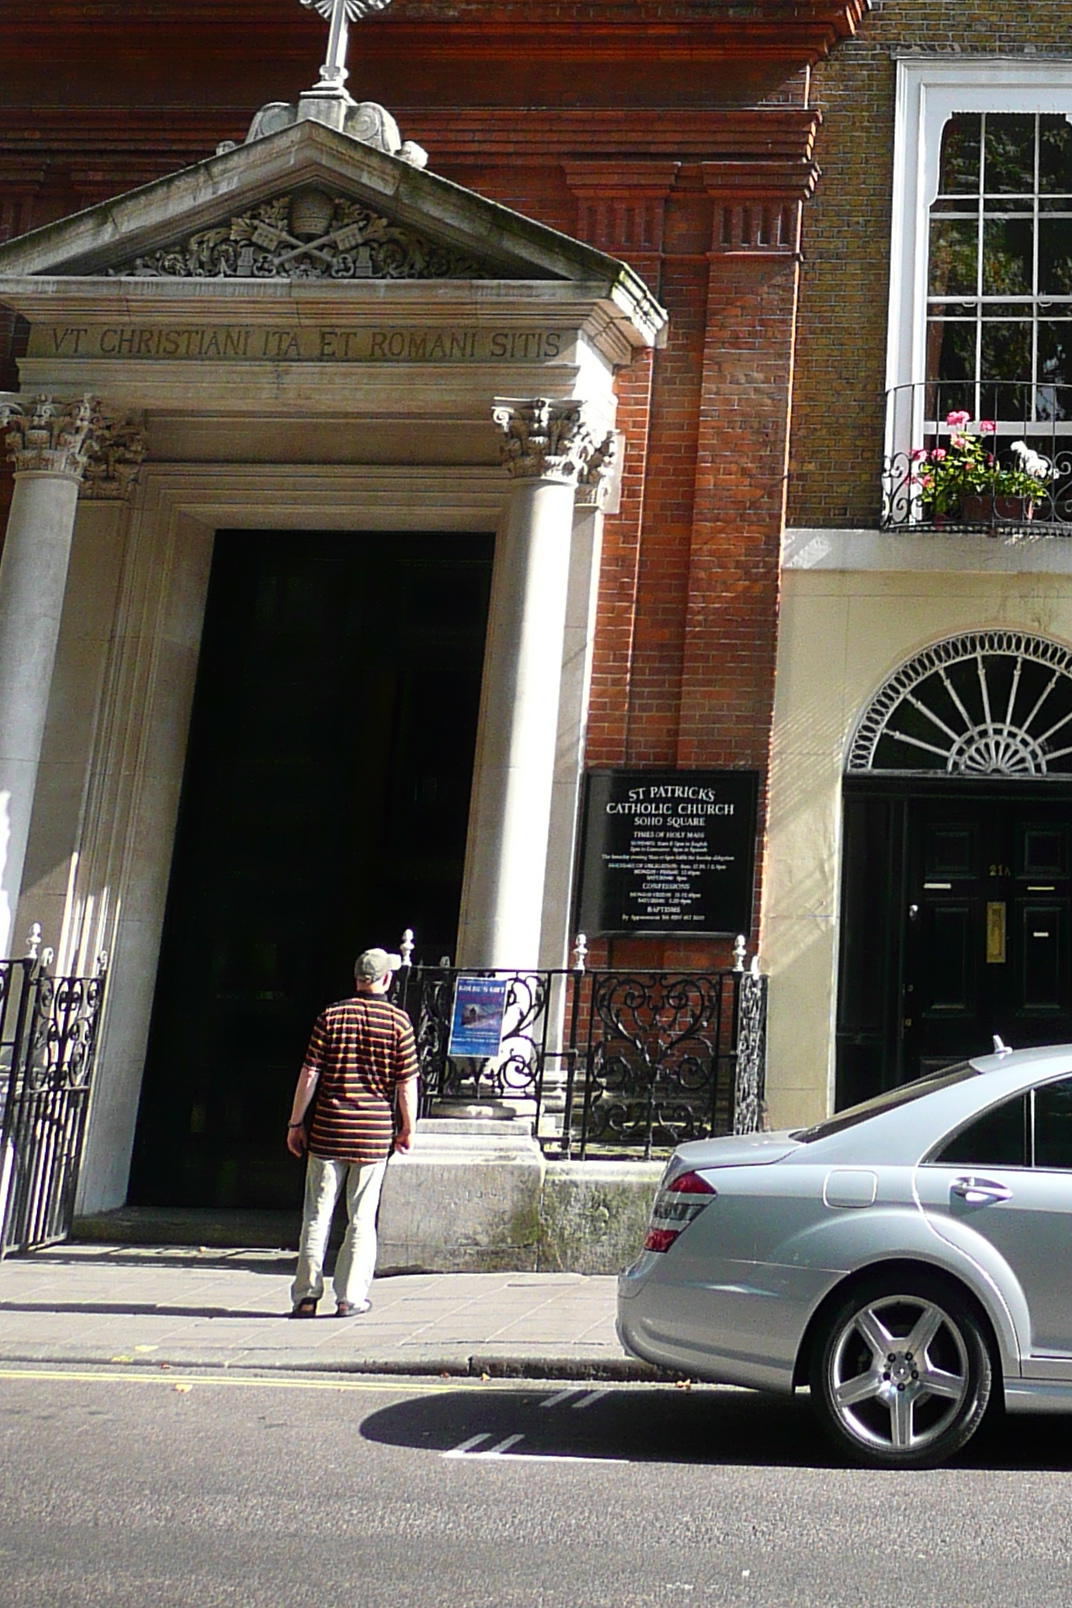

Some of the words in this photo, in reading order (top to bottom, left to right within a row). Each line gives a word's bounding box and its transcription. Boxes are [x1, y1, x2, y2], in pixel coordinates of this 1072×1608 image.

[52, 328, 88, 354] VT
[100, 328, 250, 355] CHRISTIANI
[262, 330, 301, 356] ITA
[318, 329, 357, 358] ET
[370, 331, 477, 358] ROMANI
[490, 332, 561, 358] SITIS
[628, 787, 646, 802] ST
[650, 785, 716, 803] PATRICK'S
[606, 802, 672, 815] CATHOLIC
[678, 803, 735, 815] CHURCH
[634, 816, 663, 826] SOHO
[666, 816, 706, 828] SQUARE
